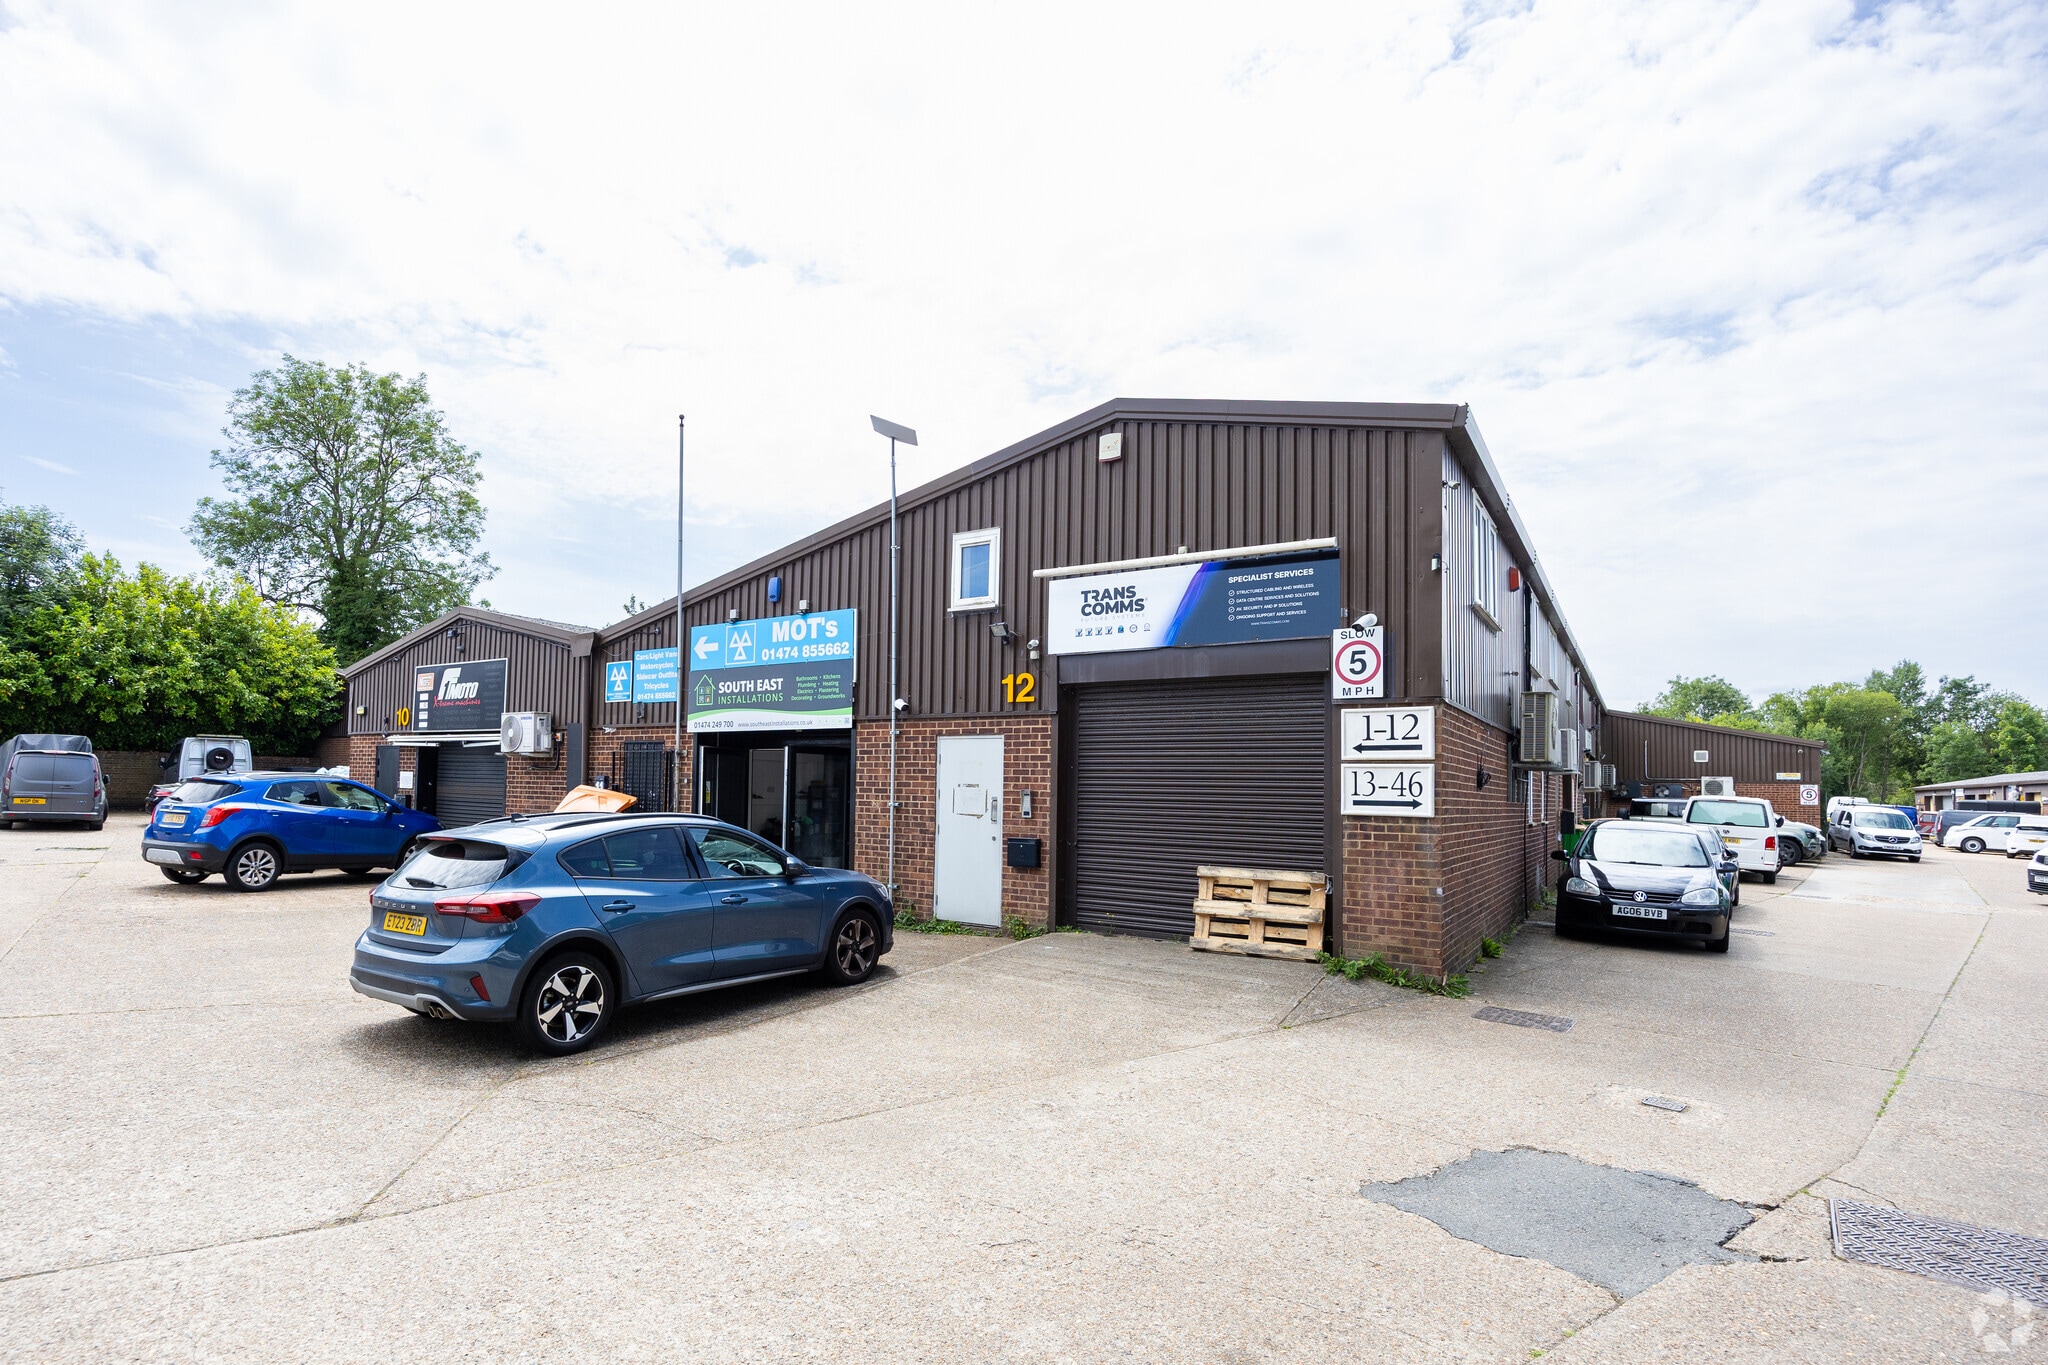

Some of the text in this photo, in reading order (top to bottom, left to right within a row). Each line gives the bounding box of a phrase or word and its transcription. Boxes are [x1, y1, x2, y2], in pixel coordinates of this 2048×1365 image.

[1228, 568, 1314, 584] SPECIALIST SERVICES
[1081, 585, 1137, 603] TRANS
[1081, 598, 1145, 616] COMMS
[1113, 612, 1145, 621] SYSTEMS
[772, 617, 838, 643] MOT's
[1340, 628, 1375, 640] SLOW
[762, 642, 849, 661] 01474 855662
[640, 662, 674, 670] Motorcycles
[1349, 650, 1367, 675] 5
[644, 682, 669, 690] Tricycles
[718, 678, 784, 694] SOUTH EAST
[1001, 672, 1034, 703] 12
[718, 692, 784, 704] INSTALLATIONS
[396, 708, 410, 726] 10
[738, 720, 813, 728] www.southeastinstallations.co.uk
[1362, 714, 1420, 742] 1-12
[1351, 771, 1424, 798] 13-46
[1806, 790, 1813, 798] 5
[1617, 906, 1663, 918] AG06 BVB
[386, 914, 406, 930] ET23
